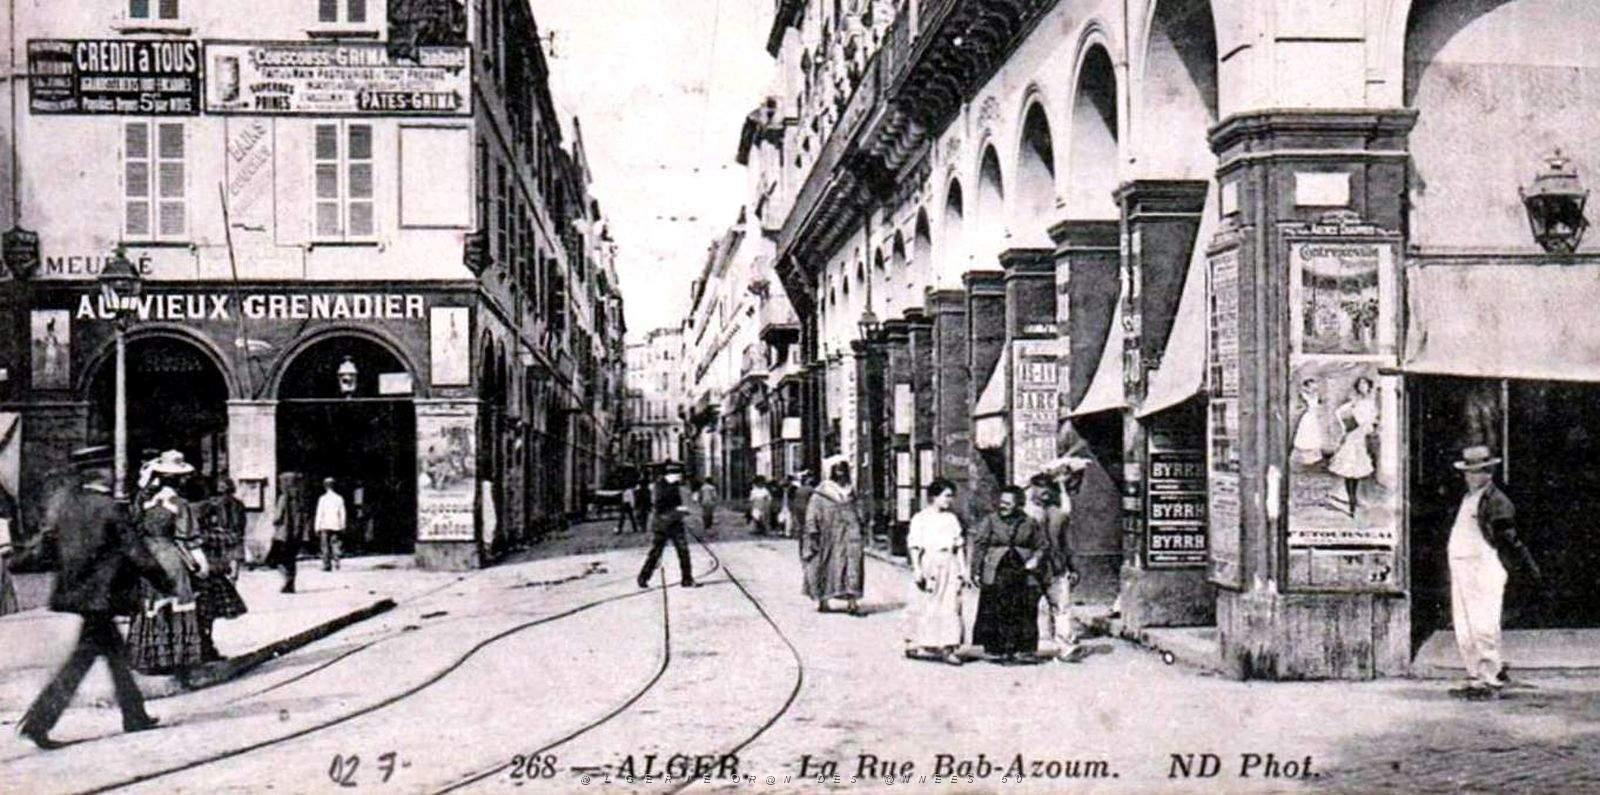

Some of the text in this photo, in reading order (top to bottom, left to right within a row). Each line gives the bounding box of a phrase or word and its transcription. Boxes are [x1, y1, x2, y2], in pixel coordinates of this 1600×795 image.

[77, 42, 136, 72] CREDIT
[153, 42, 195, 72] TOUS
[46, 252, 152, 275] MEUÉ
[136, 293, 230, 320] VIEUX
[245, 293, 425, 320] GRENADIER
[1153, 503, 1205, 518] BYRRH
[1153, 534, 1205, 549] BYRRH
